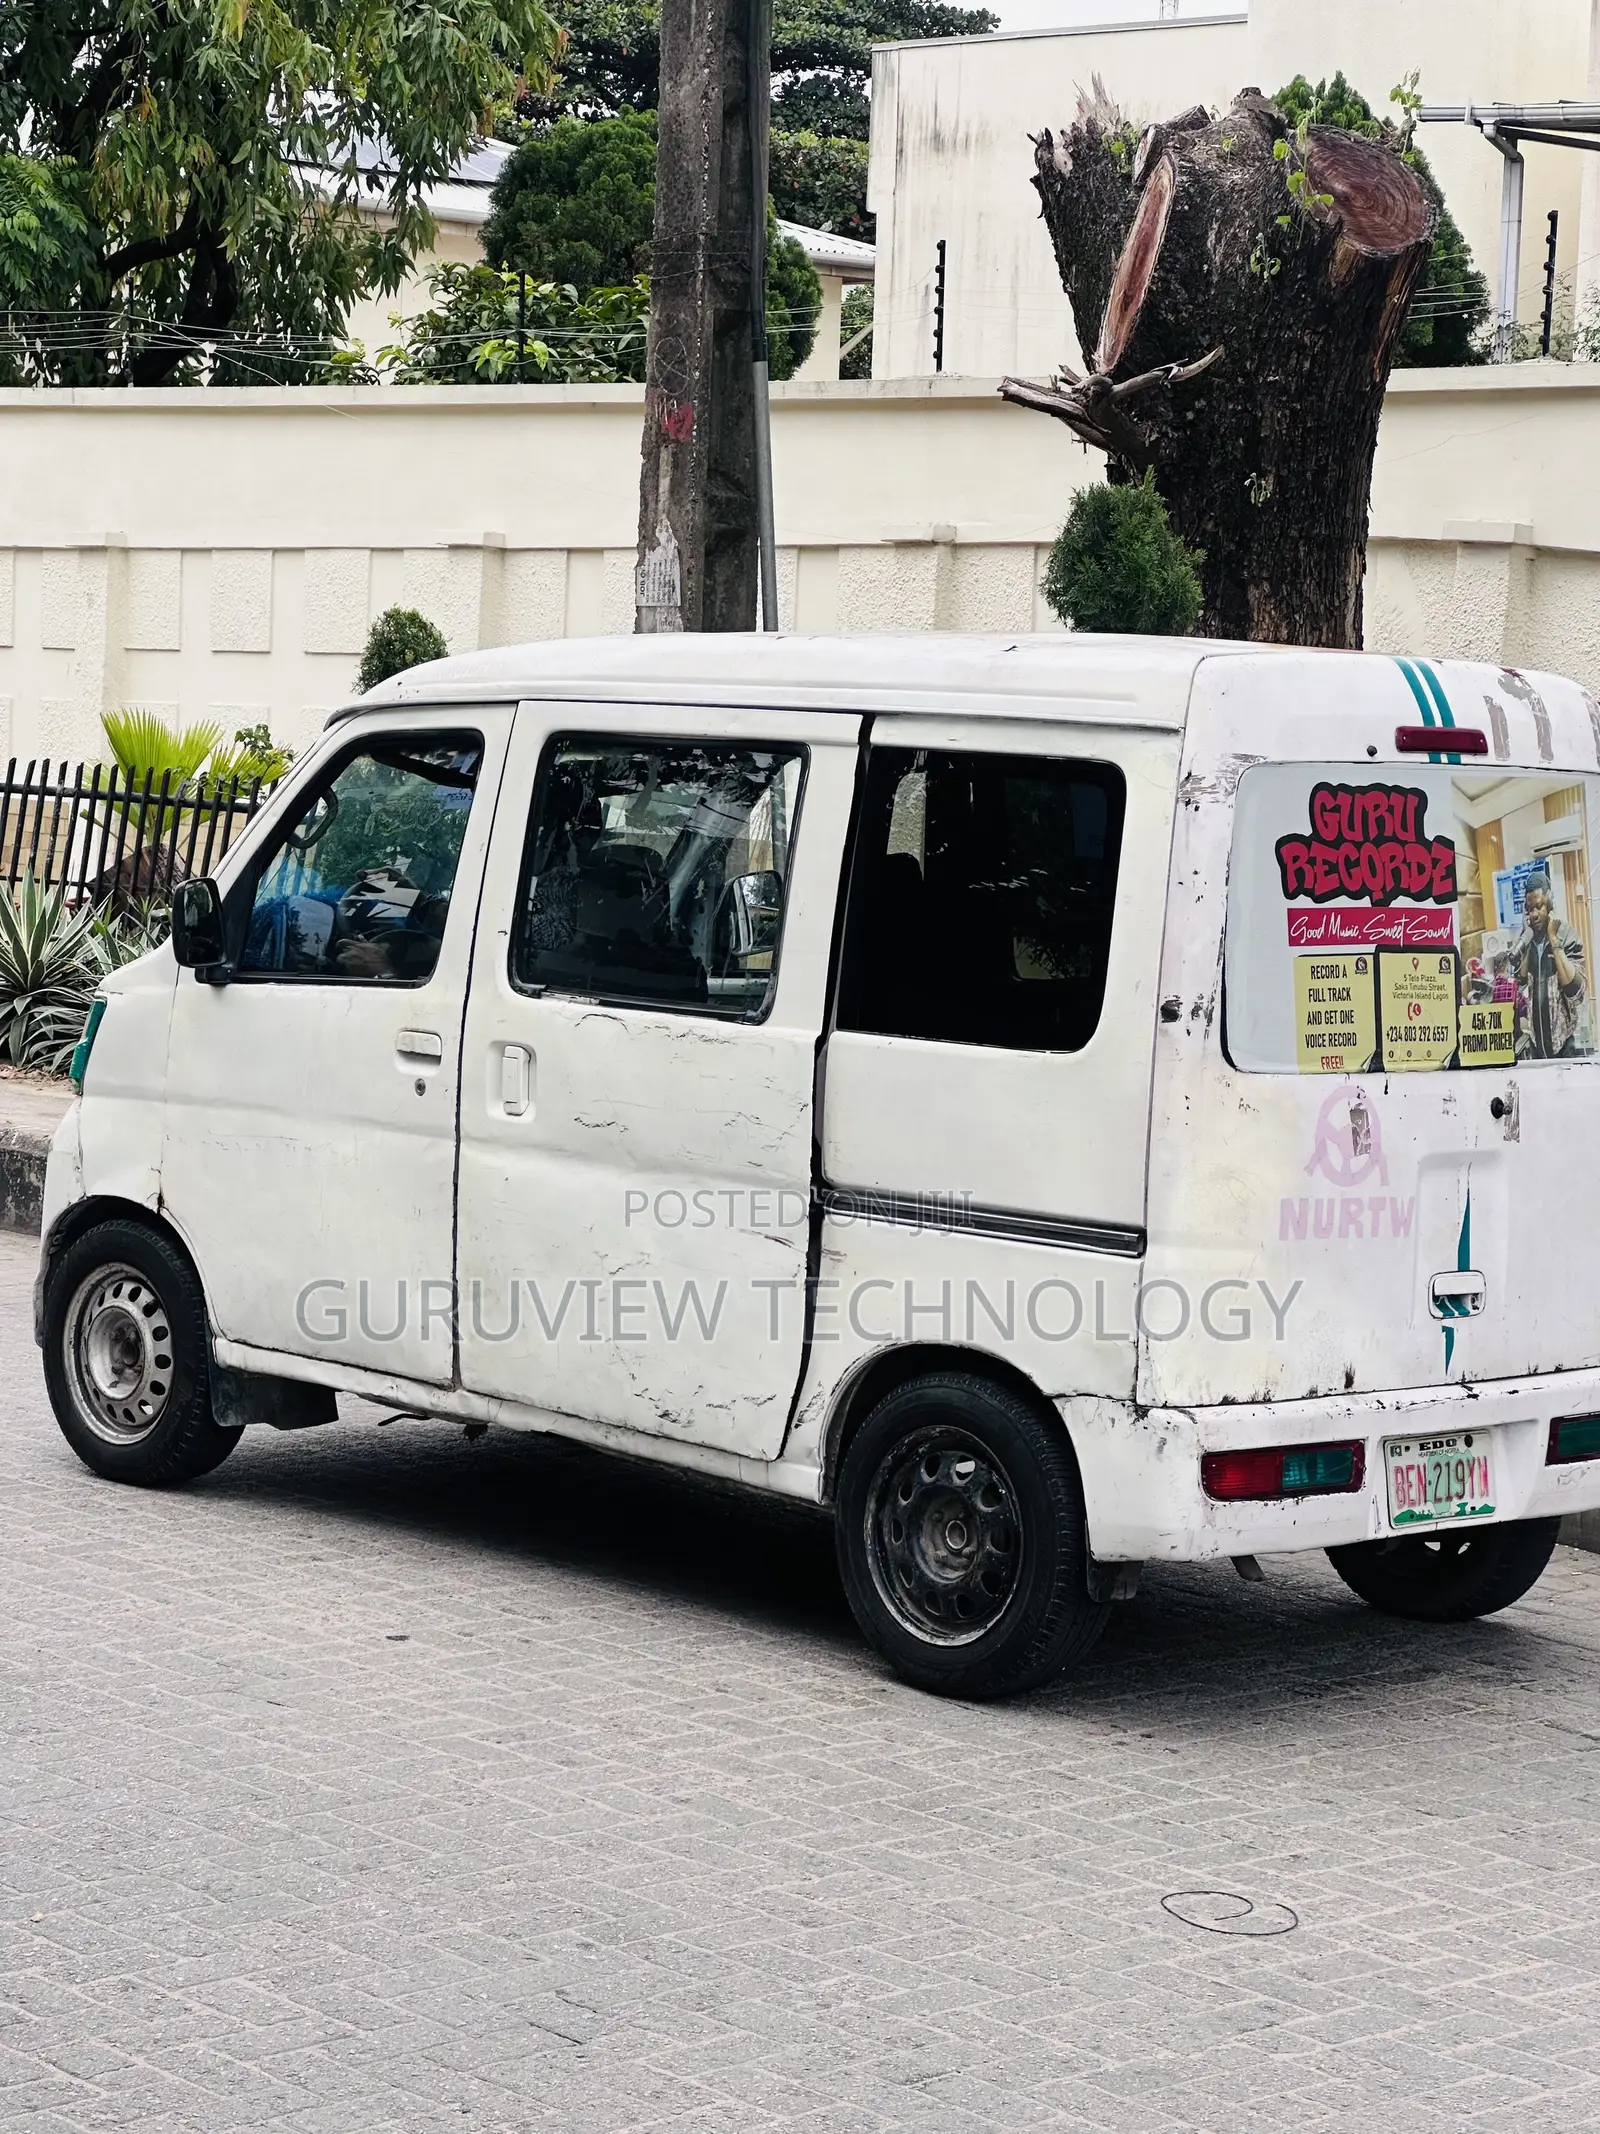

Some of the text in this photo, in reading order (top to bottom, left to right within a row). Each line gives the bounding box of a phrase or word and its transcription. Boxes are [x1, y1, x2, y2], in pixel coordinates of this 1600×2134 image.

[1313, 789, 1419, 843] GURU
[1280, 840, 1454, 902] RECORDZ
[1290, 914, 1326, 944] Good
[1363, 913, 1410, 947] Sweet
[1406, 914, 1452, 941] Sound
[1310, 964, 1348, 980] RECORD A
[1308, 987, 1352, 1003] FULL TRACK
[1394, 982, 1409, 991] Saka
[1392, 991, 1449, 1002] Victoria Island Lagos
[1307, 1009, 1355, 1026] AND GET ONE
[1305, 1032, 1357, 1049] VOICE RECORD
[1386, 1026, 1449, 1042] +234 803 292 6557
[1462, 1034, 1488, 1053] PROMO
[1278, 1196, 1416, 1241] NURTW
[1418, 1438, 1458, 1451] EDO
